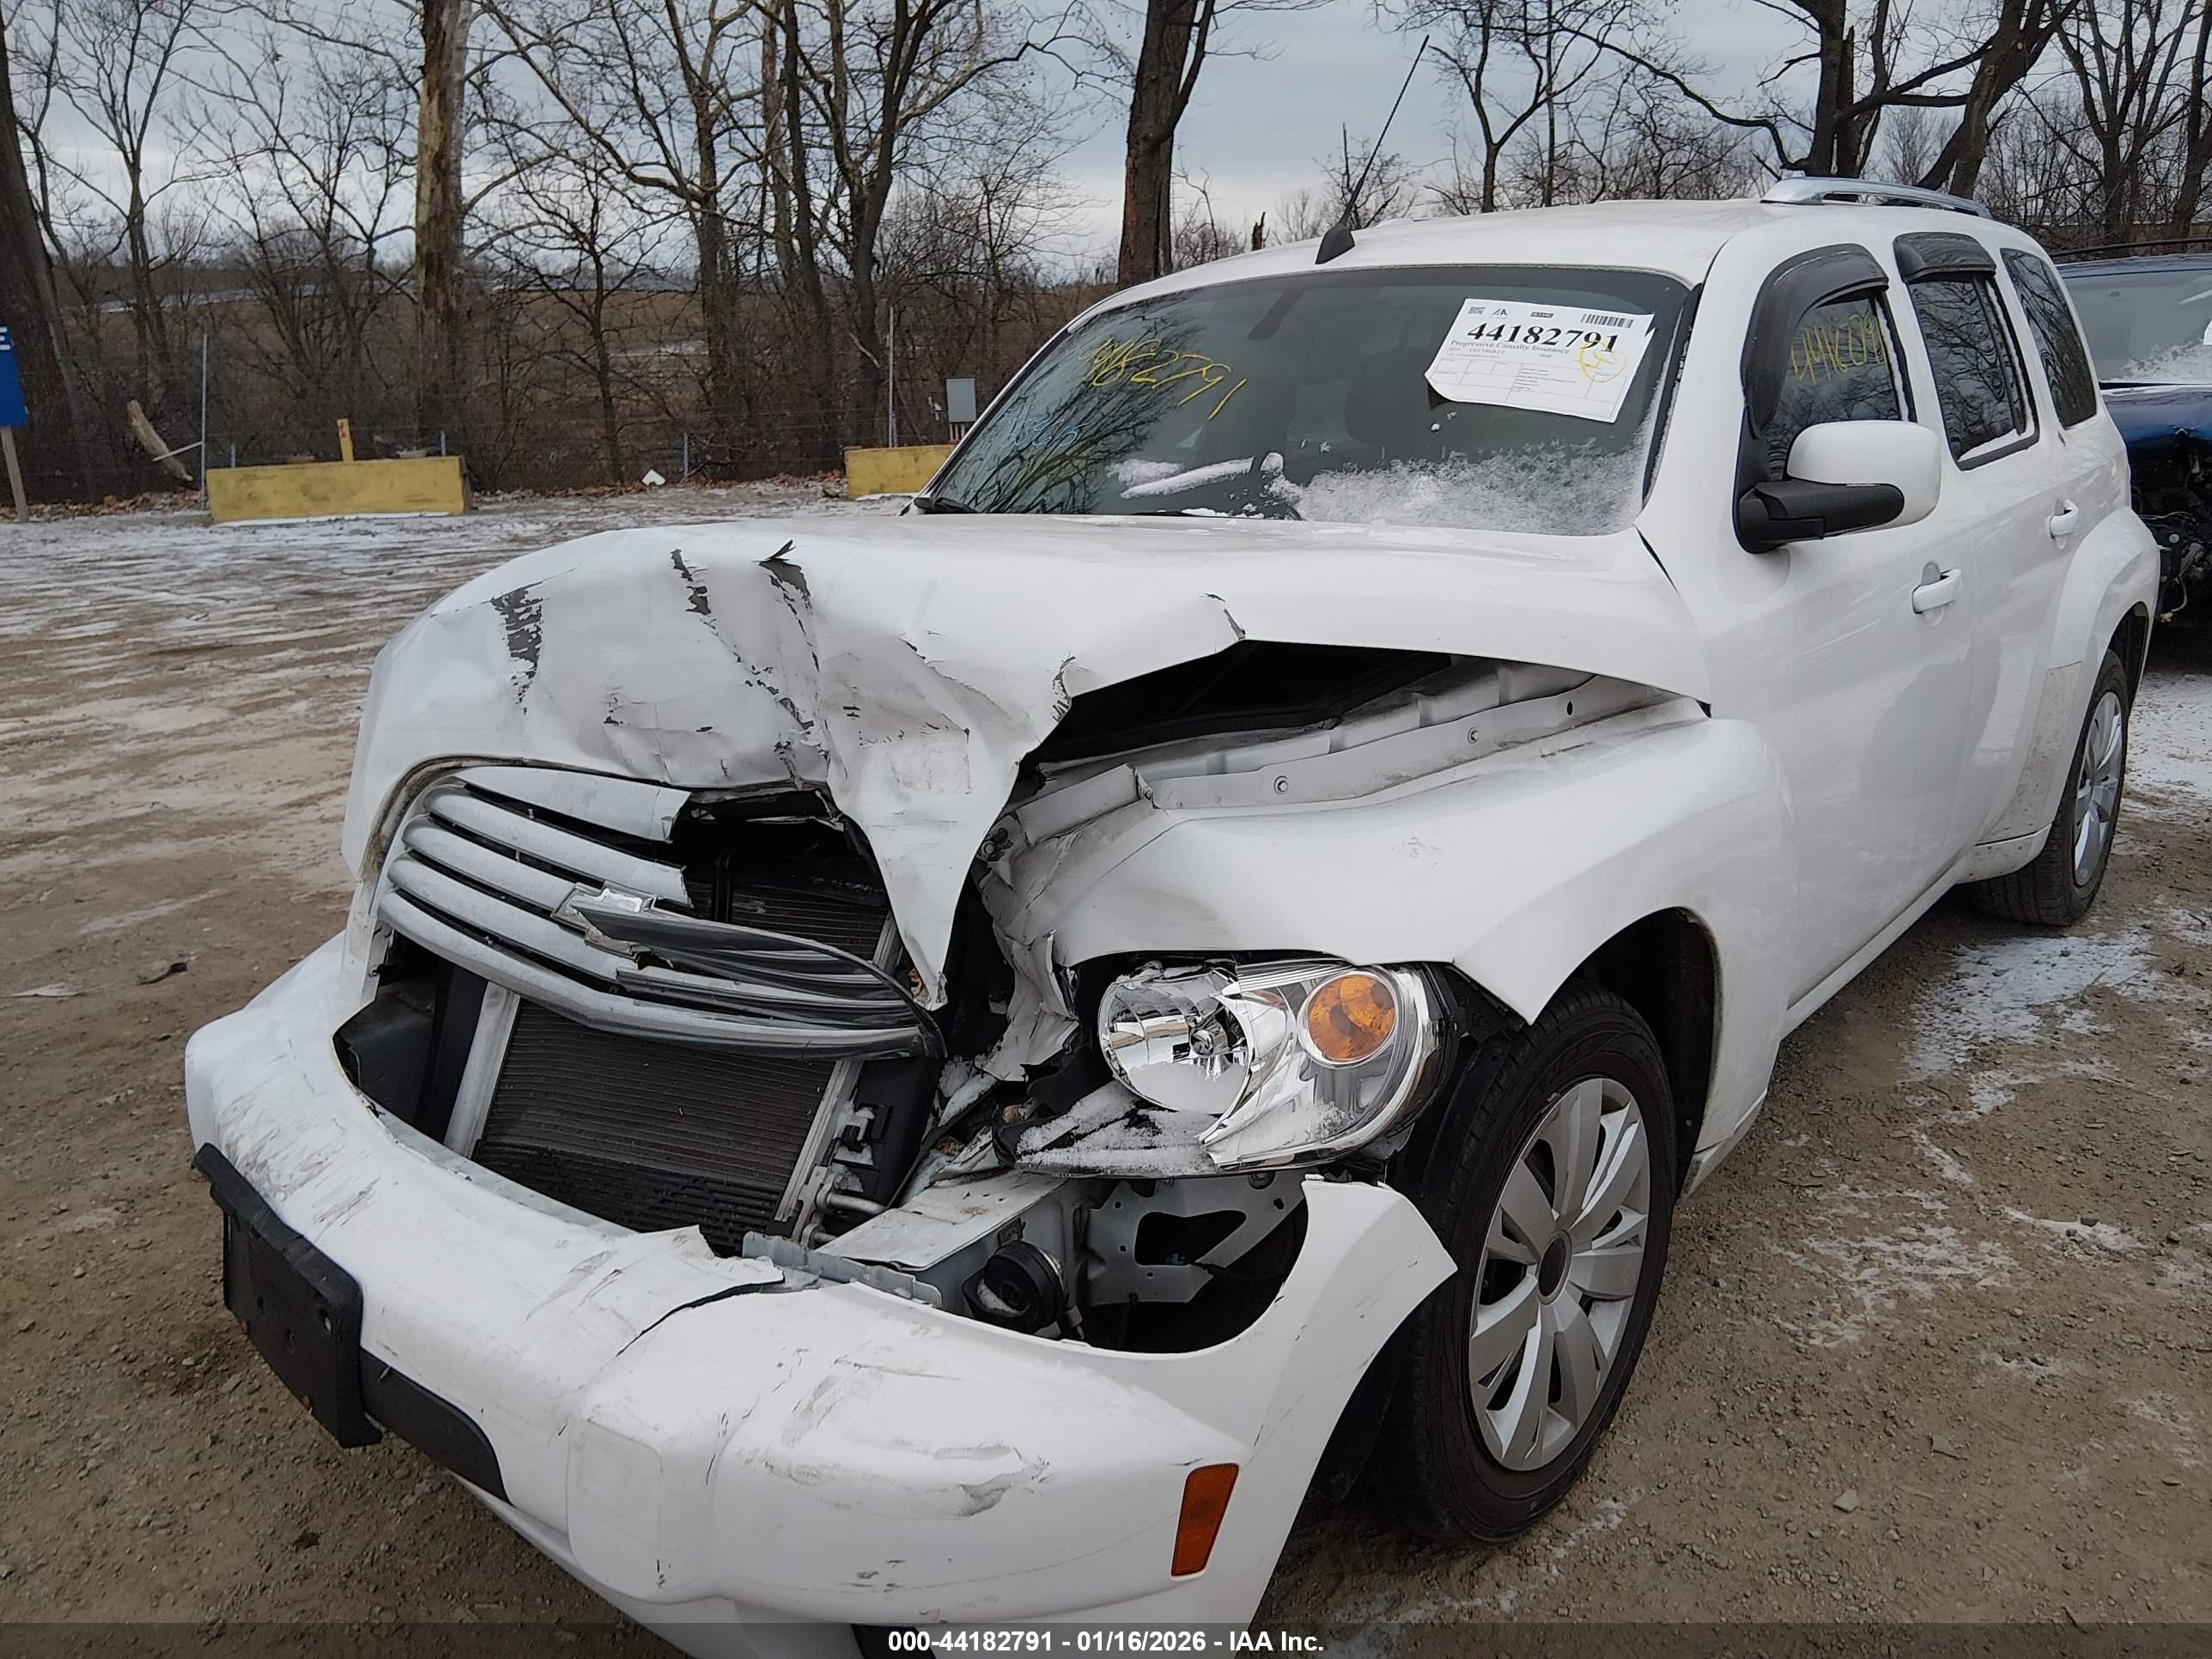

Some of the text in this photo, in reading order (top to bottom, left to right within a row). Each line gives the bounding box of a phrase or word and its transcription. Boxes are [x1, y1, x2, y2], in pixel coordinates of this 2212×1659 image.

[1450, 339, 1571, 355] Progressive Casualty Insurance
[1468, 322, 1620, 353] 44182791
